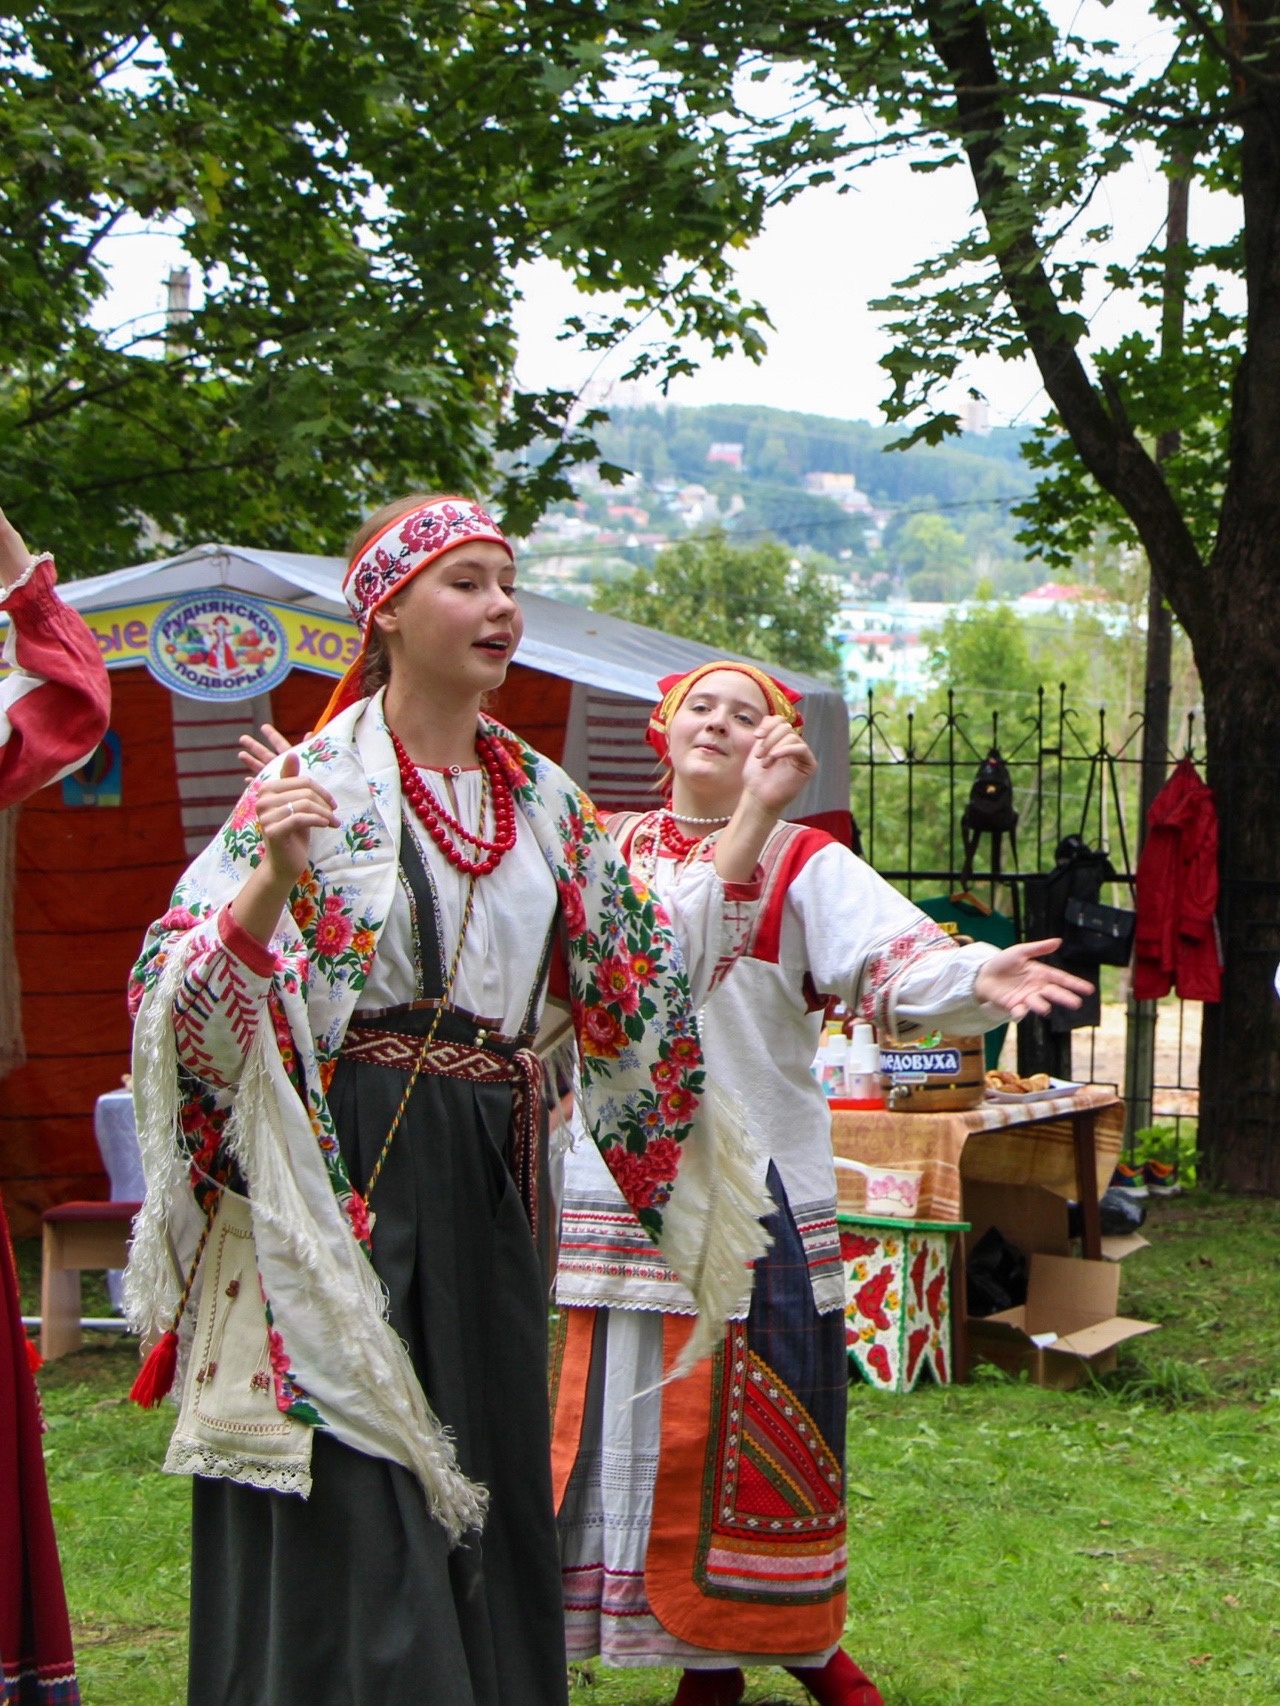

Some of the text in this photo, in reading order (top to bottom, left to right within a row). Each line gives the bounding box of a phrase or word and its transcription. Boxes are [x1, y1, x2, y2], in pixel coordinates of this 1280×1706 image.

[90, 620, 361, 665] ые хоз
[174, 662, 267, 689] ПОДВОРЬЕ
